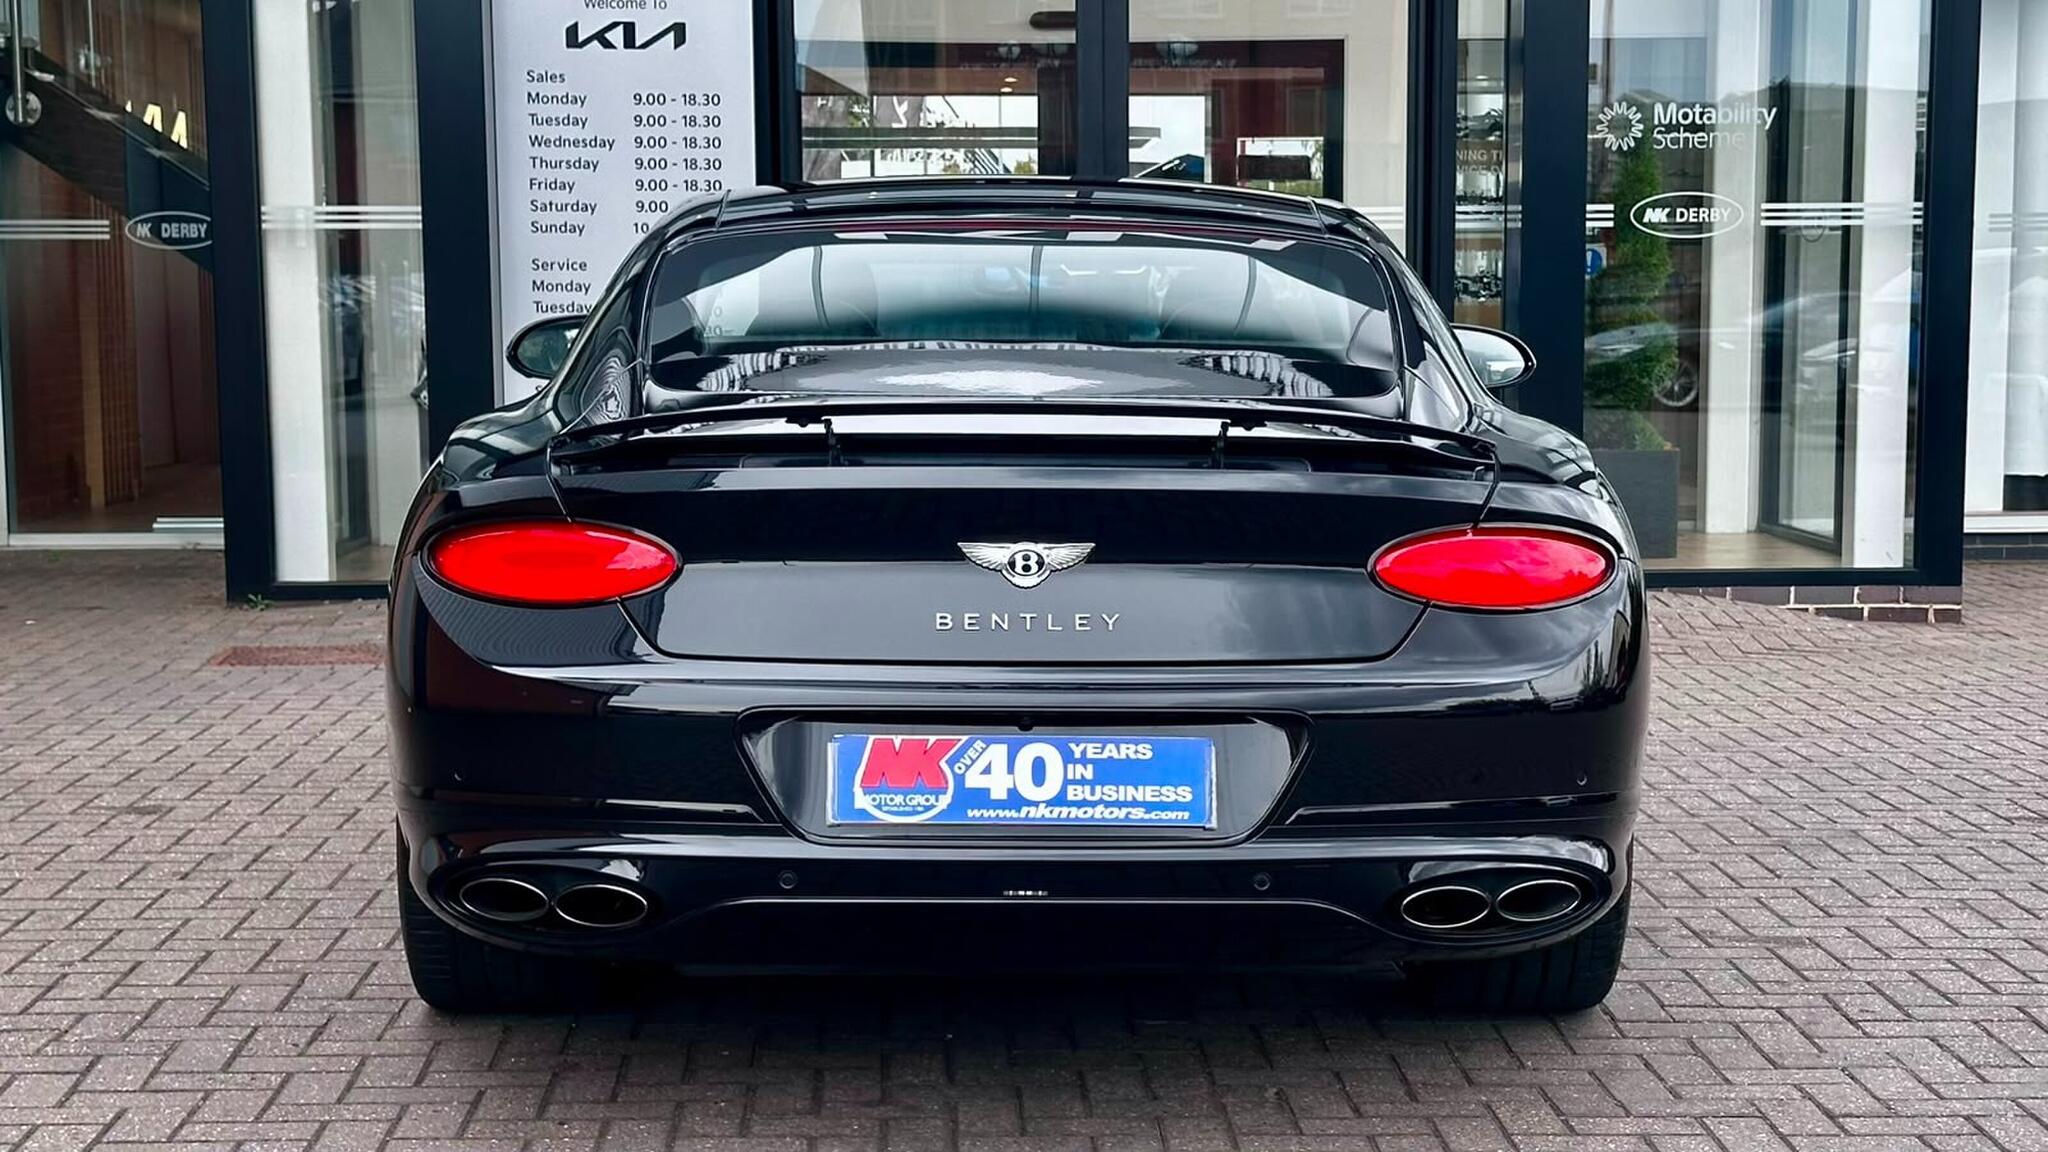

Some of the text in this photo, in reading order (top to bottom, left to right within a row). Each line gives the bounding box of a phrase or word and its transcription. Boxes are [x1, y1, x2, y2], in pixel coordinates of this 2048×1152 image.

[565, 21, 687, 51] KIA
[526, 69, 566, 84] Sales
[526, 91, 588, 109] Monday
[633, 92, 667, 107] 9.00
[682, 92, 721, 107] 18.30
[528, 112, 589, 130] Tuesday
[633, 114, 667, 128] 9.00
[682, 114, 721, 128] 18.30
[1653, 102, 1777, 130] Motability
[529, 134, 616, 152] Wednesday
[634, 135, 668, 150] 9.00
[683, 135, 722, 150] 18.30
[1653, 126, 1746, 150] Scheme
[529, 156, 600, 174] Thursday
[634, 157, 668, 171] 9.00
[683, 157, 722, 171] 18.30
[529, 177, 576, 195] Friday
[635, 178, 669, 192] 9.00
[684, 178, 723, 192] 18.30
[530, 199, 669, 217] Saturday 9.00
[1643, 207, 1732, 223] NK DERBY
[160, 222, 208, 239] DERBY
[530, 221, 586, 238] Sunday
[531, 258, 588, 272] Service
[531, 279, 592, 296] Monday
[533, 300, 592, 314] Tuesday
[935, 612, 1120, 632] BENTLEY
[953, 739, 988, 775] OVER
[1068, 743, 1154, 760] YEARS
[860, 737, 962, 789] NK
[965, 742, 1065, 802] 40
[1066, 764, 1094, 780] IN
[1066, 785, 1194, 802] BUSINESS
[966, 802, 1190, 820] www.nkmotors.com
